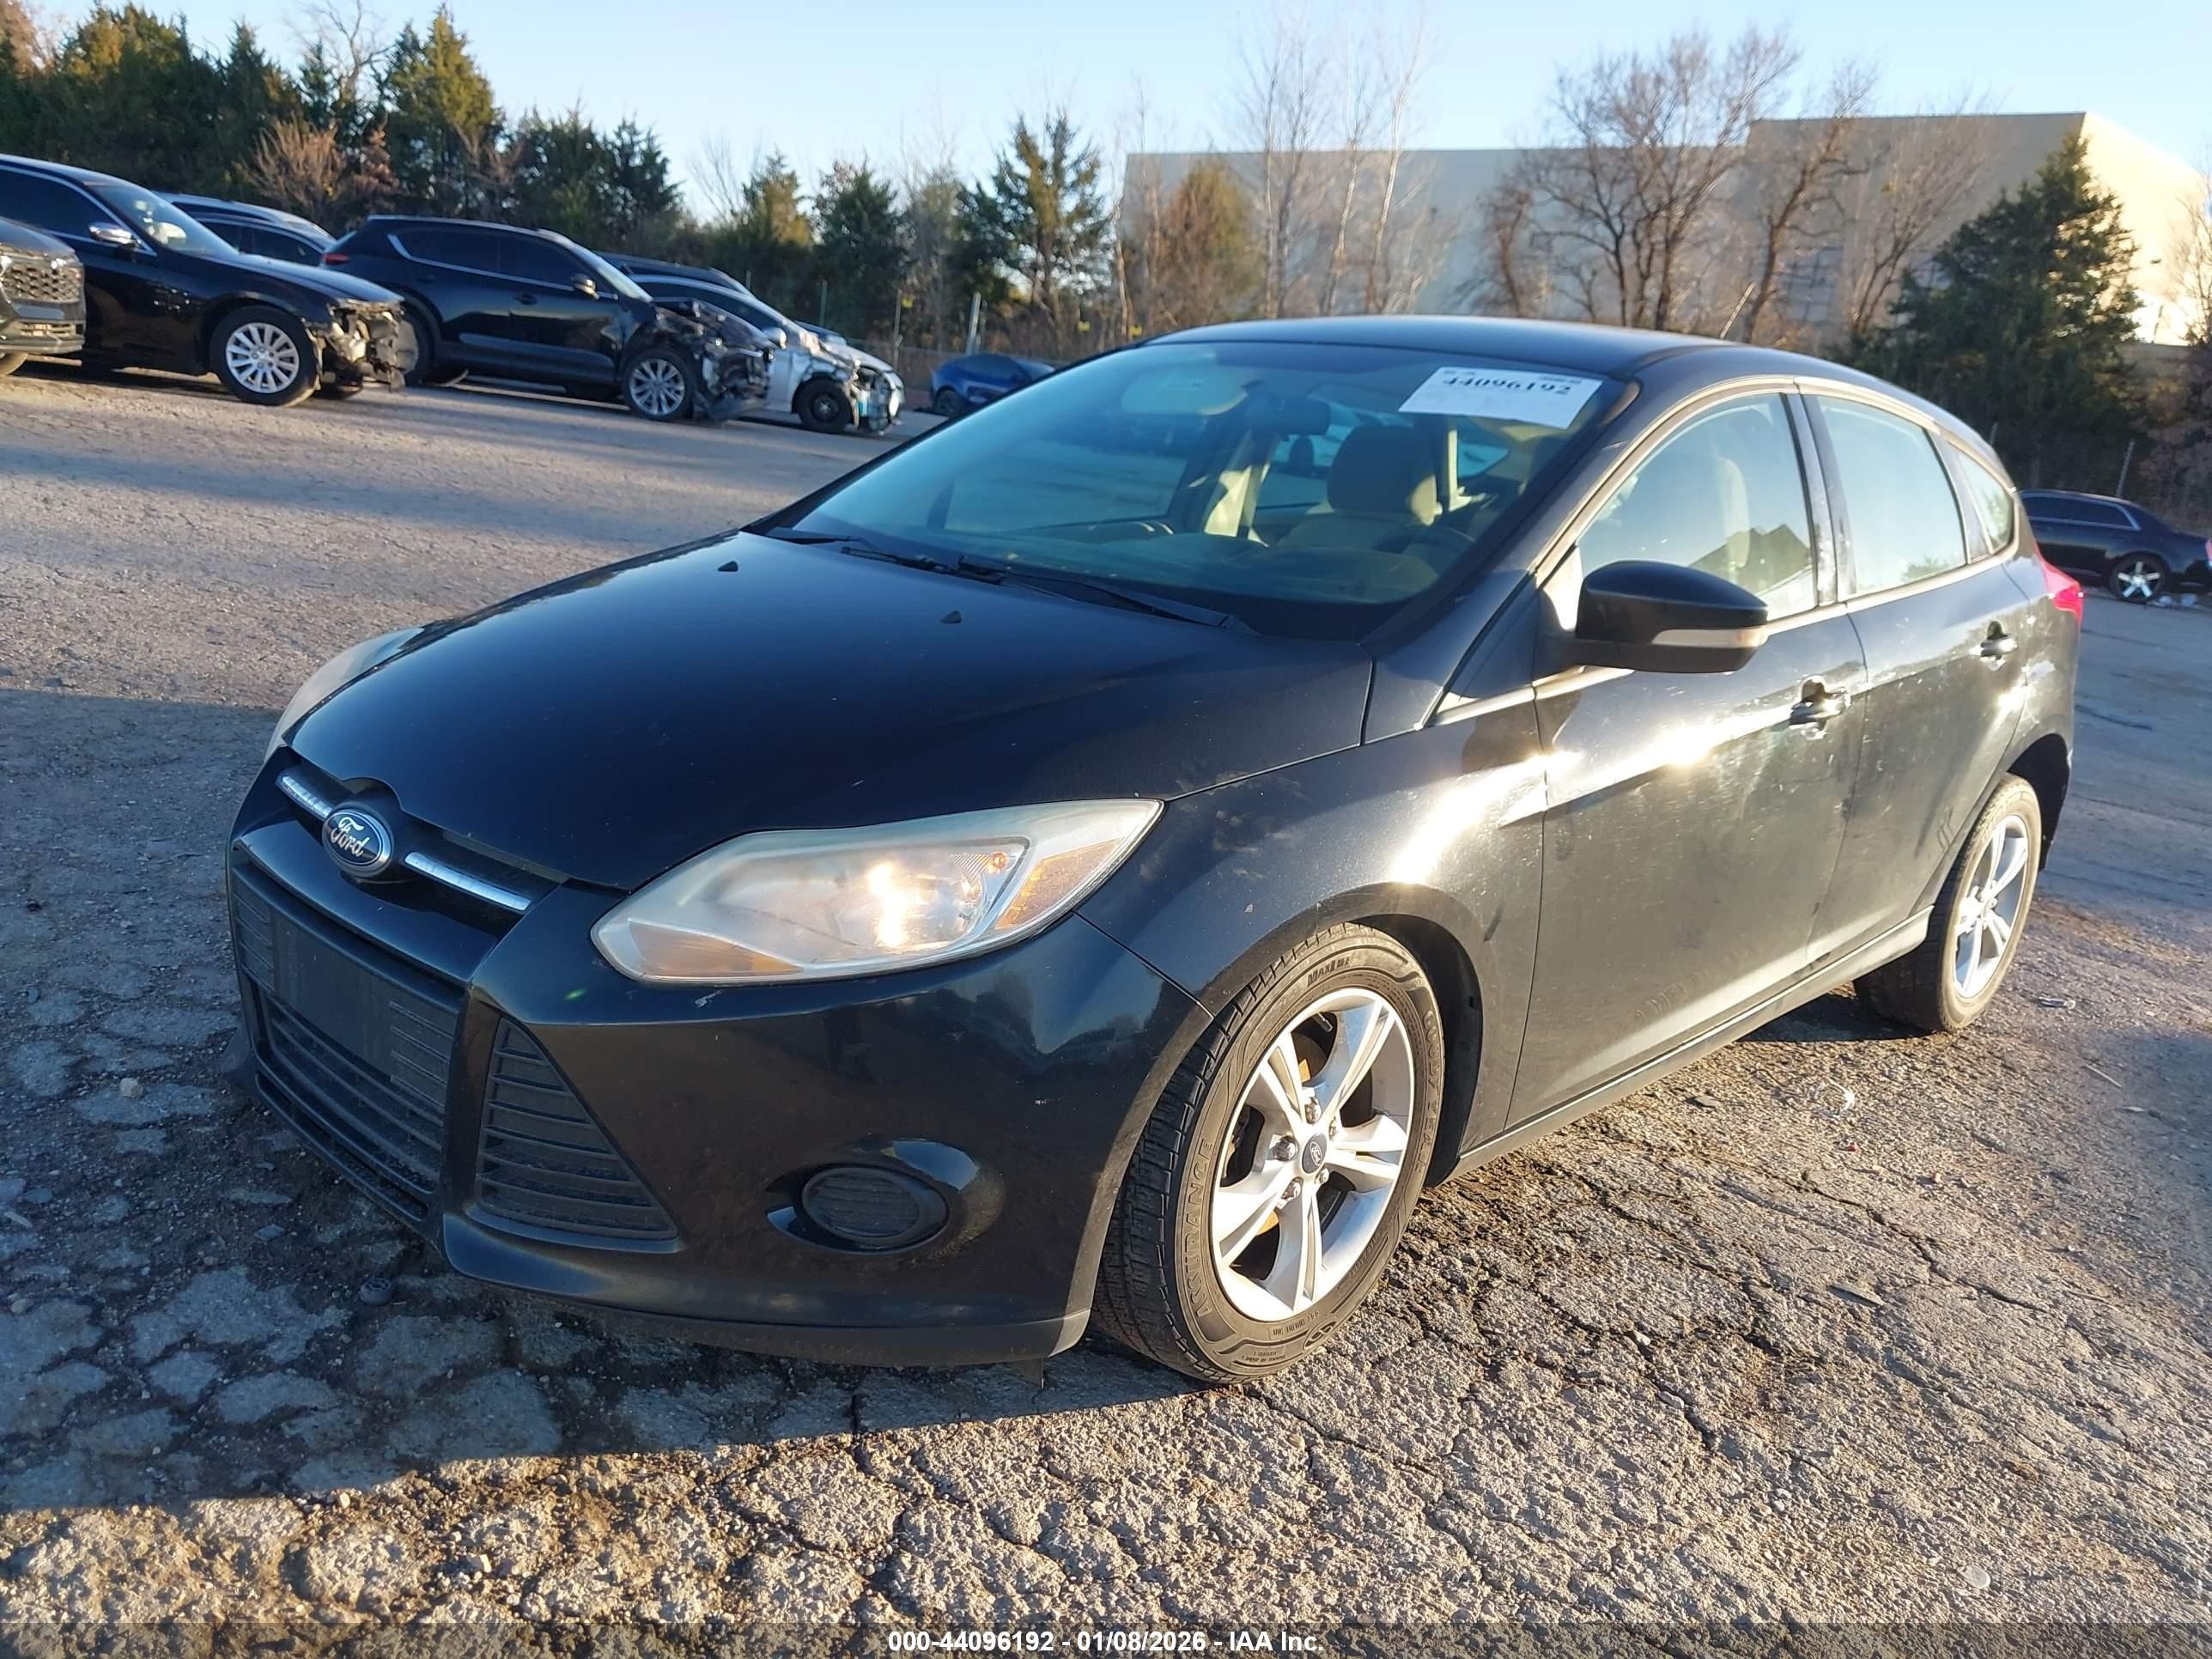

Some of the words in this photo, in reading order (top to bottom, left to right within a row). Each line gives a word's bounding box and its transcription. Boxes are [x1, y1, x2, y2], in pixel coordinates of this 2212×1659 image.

[1443, 377, 1571, 395] 44096192
[330, 817, 370, 857] Ford
[1185, 1138, 1212, 1317] ASSURANCE
